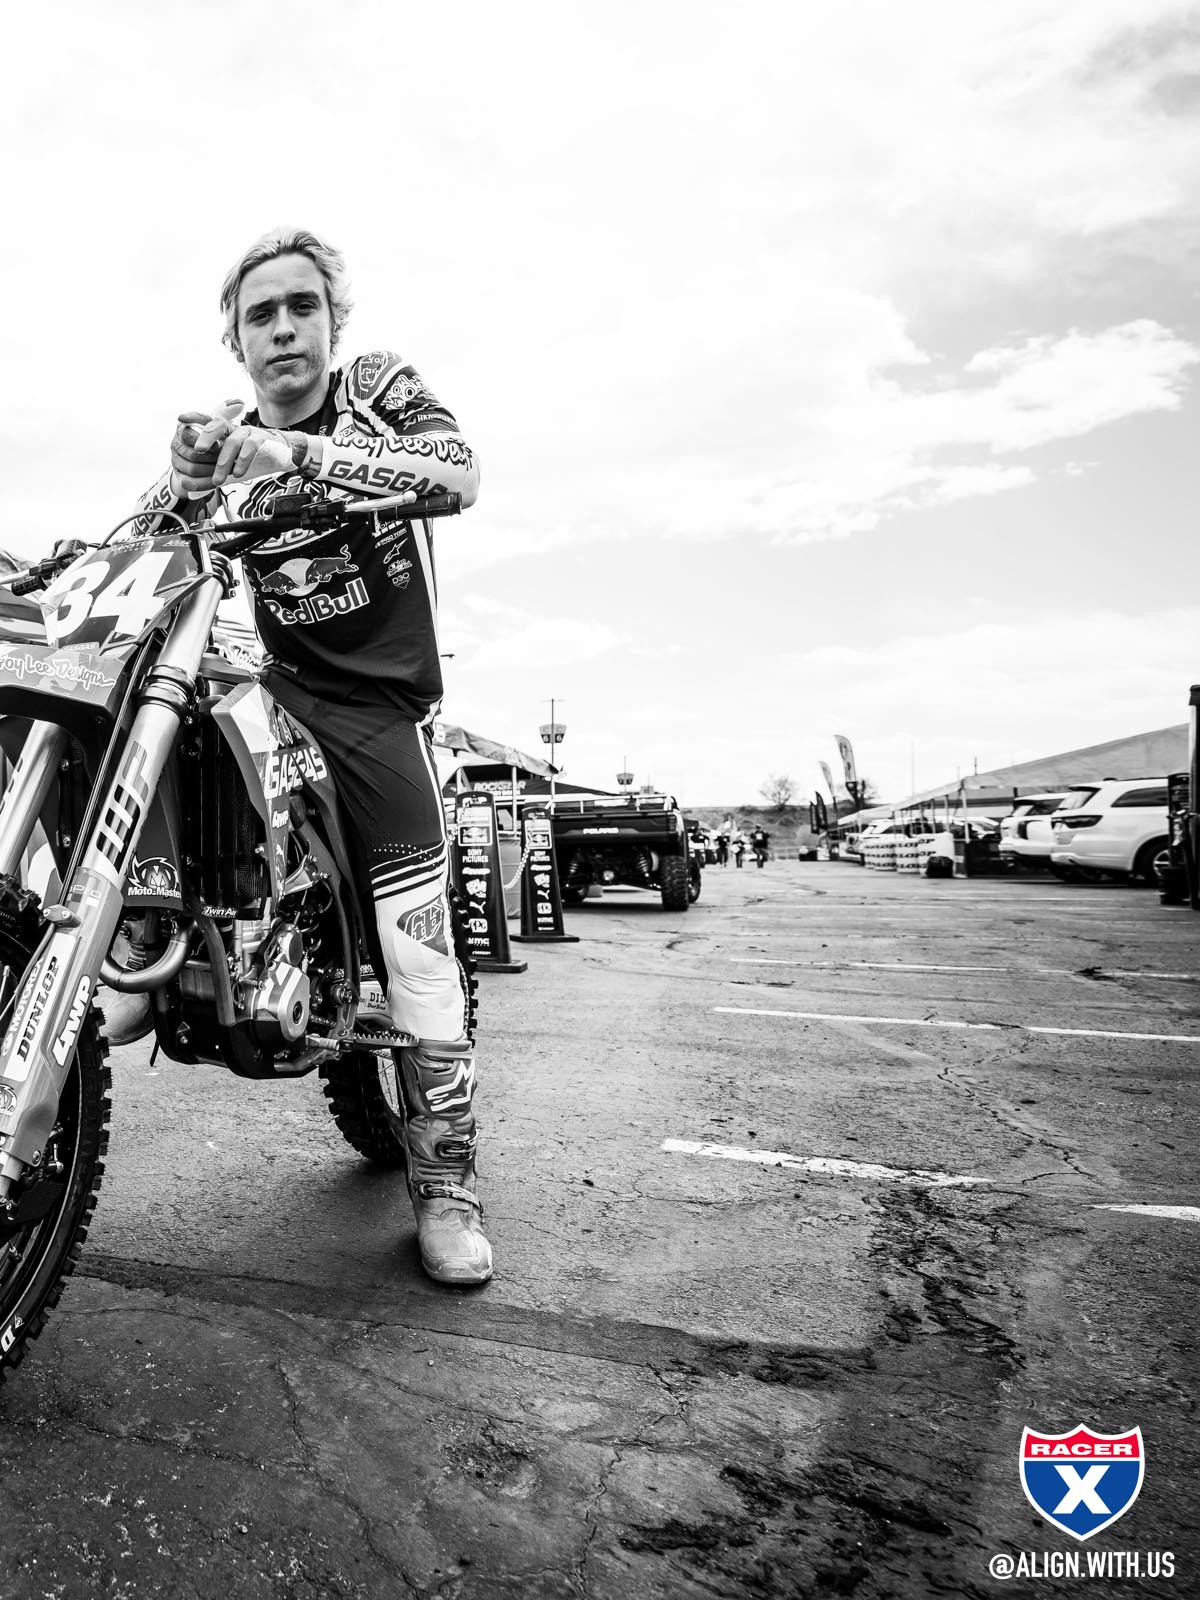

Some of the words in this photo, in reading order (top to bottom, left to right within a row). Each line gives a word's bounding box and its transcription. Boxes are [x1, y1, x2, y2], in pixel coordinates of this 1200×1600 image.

[263, 600, 311, 626] Red
[310, 577, 370, 623] Bull
[17, 956, 59, 1062] DUNLOP
